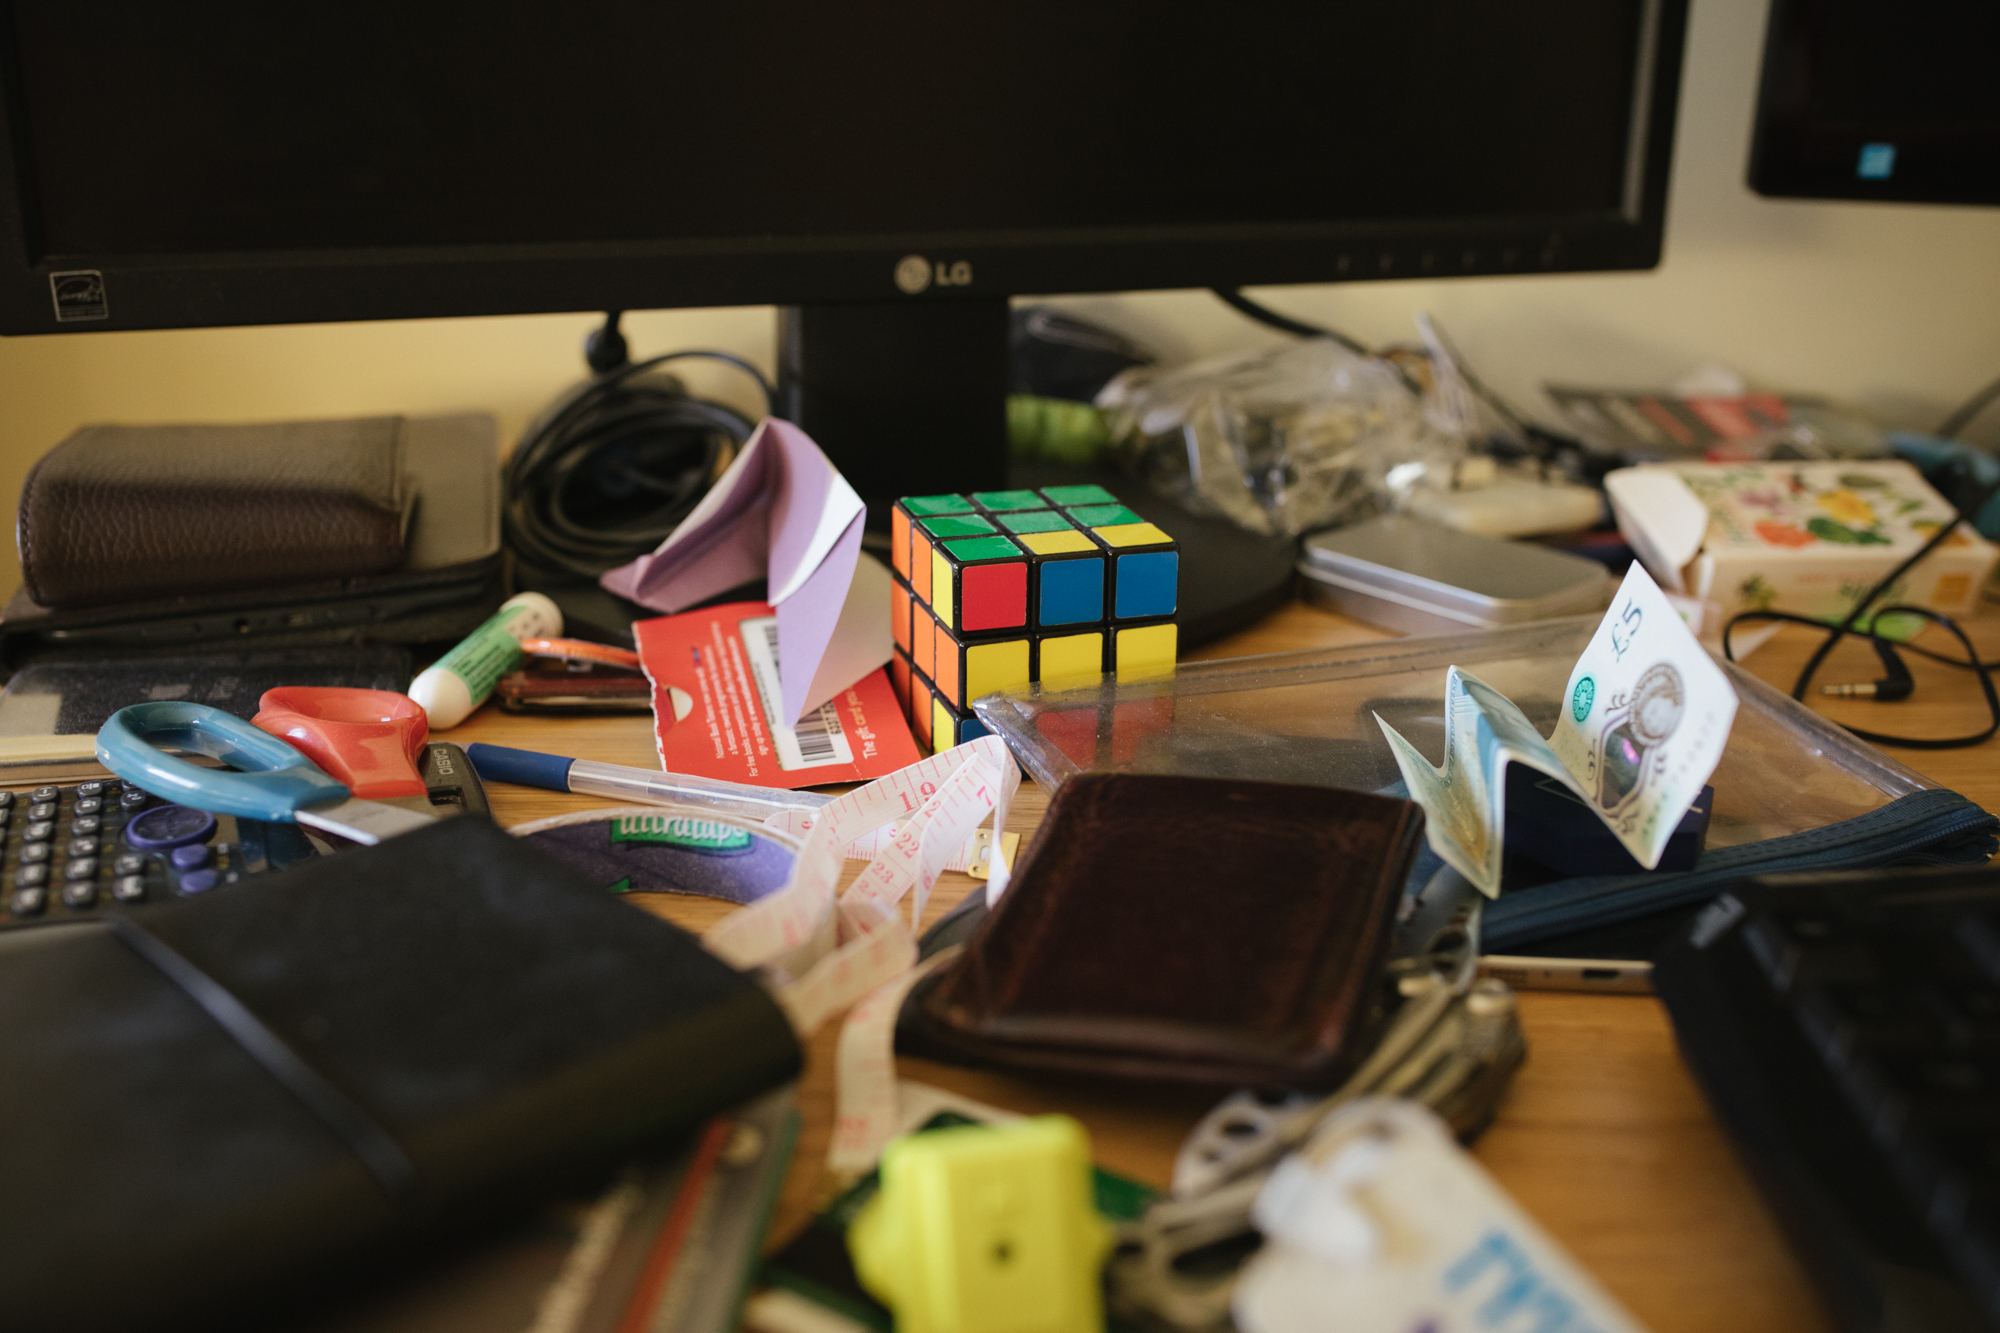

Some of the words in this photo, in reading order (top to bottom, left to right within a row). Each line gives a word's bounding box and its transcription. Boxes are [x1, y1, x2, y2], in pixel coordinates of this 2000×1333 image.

[935, 260, 973, 287] LG
[1610, 597, 1643, 663] £5
[848, 707, 866, 726] card
[855, 726, 876, 740] gift
[747, 755, 755, 767] free
[863, 741, 878, 759] The
[433, 748, 454, 775] CASIO
[749, 766, 758, 777] For
[898, 782, 937, 813] 19
[976, 785, 993, 807] 7
[895, 832, 921, 859] 22
[871, 861, 894, 884] 23
